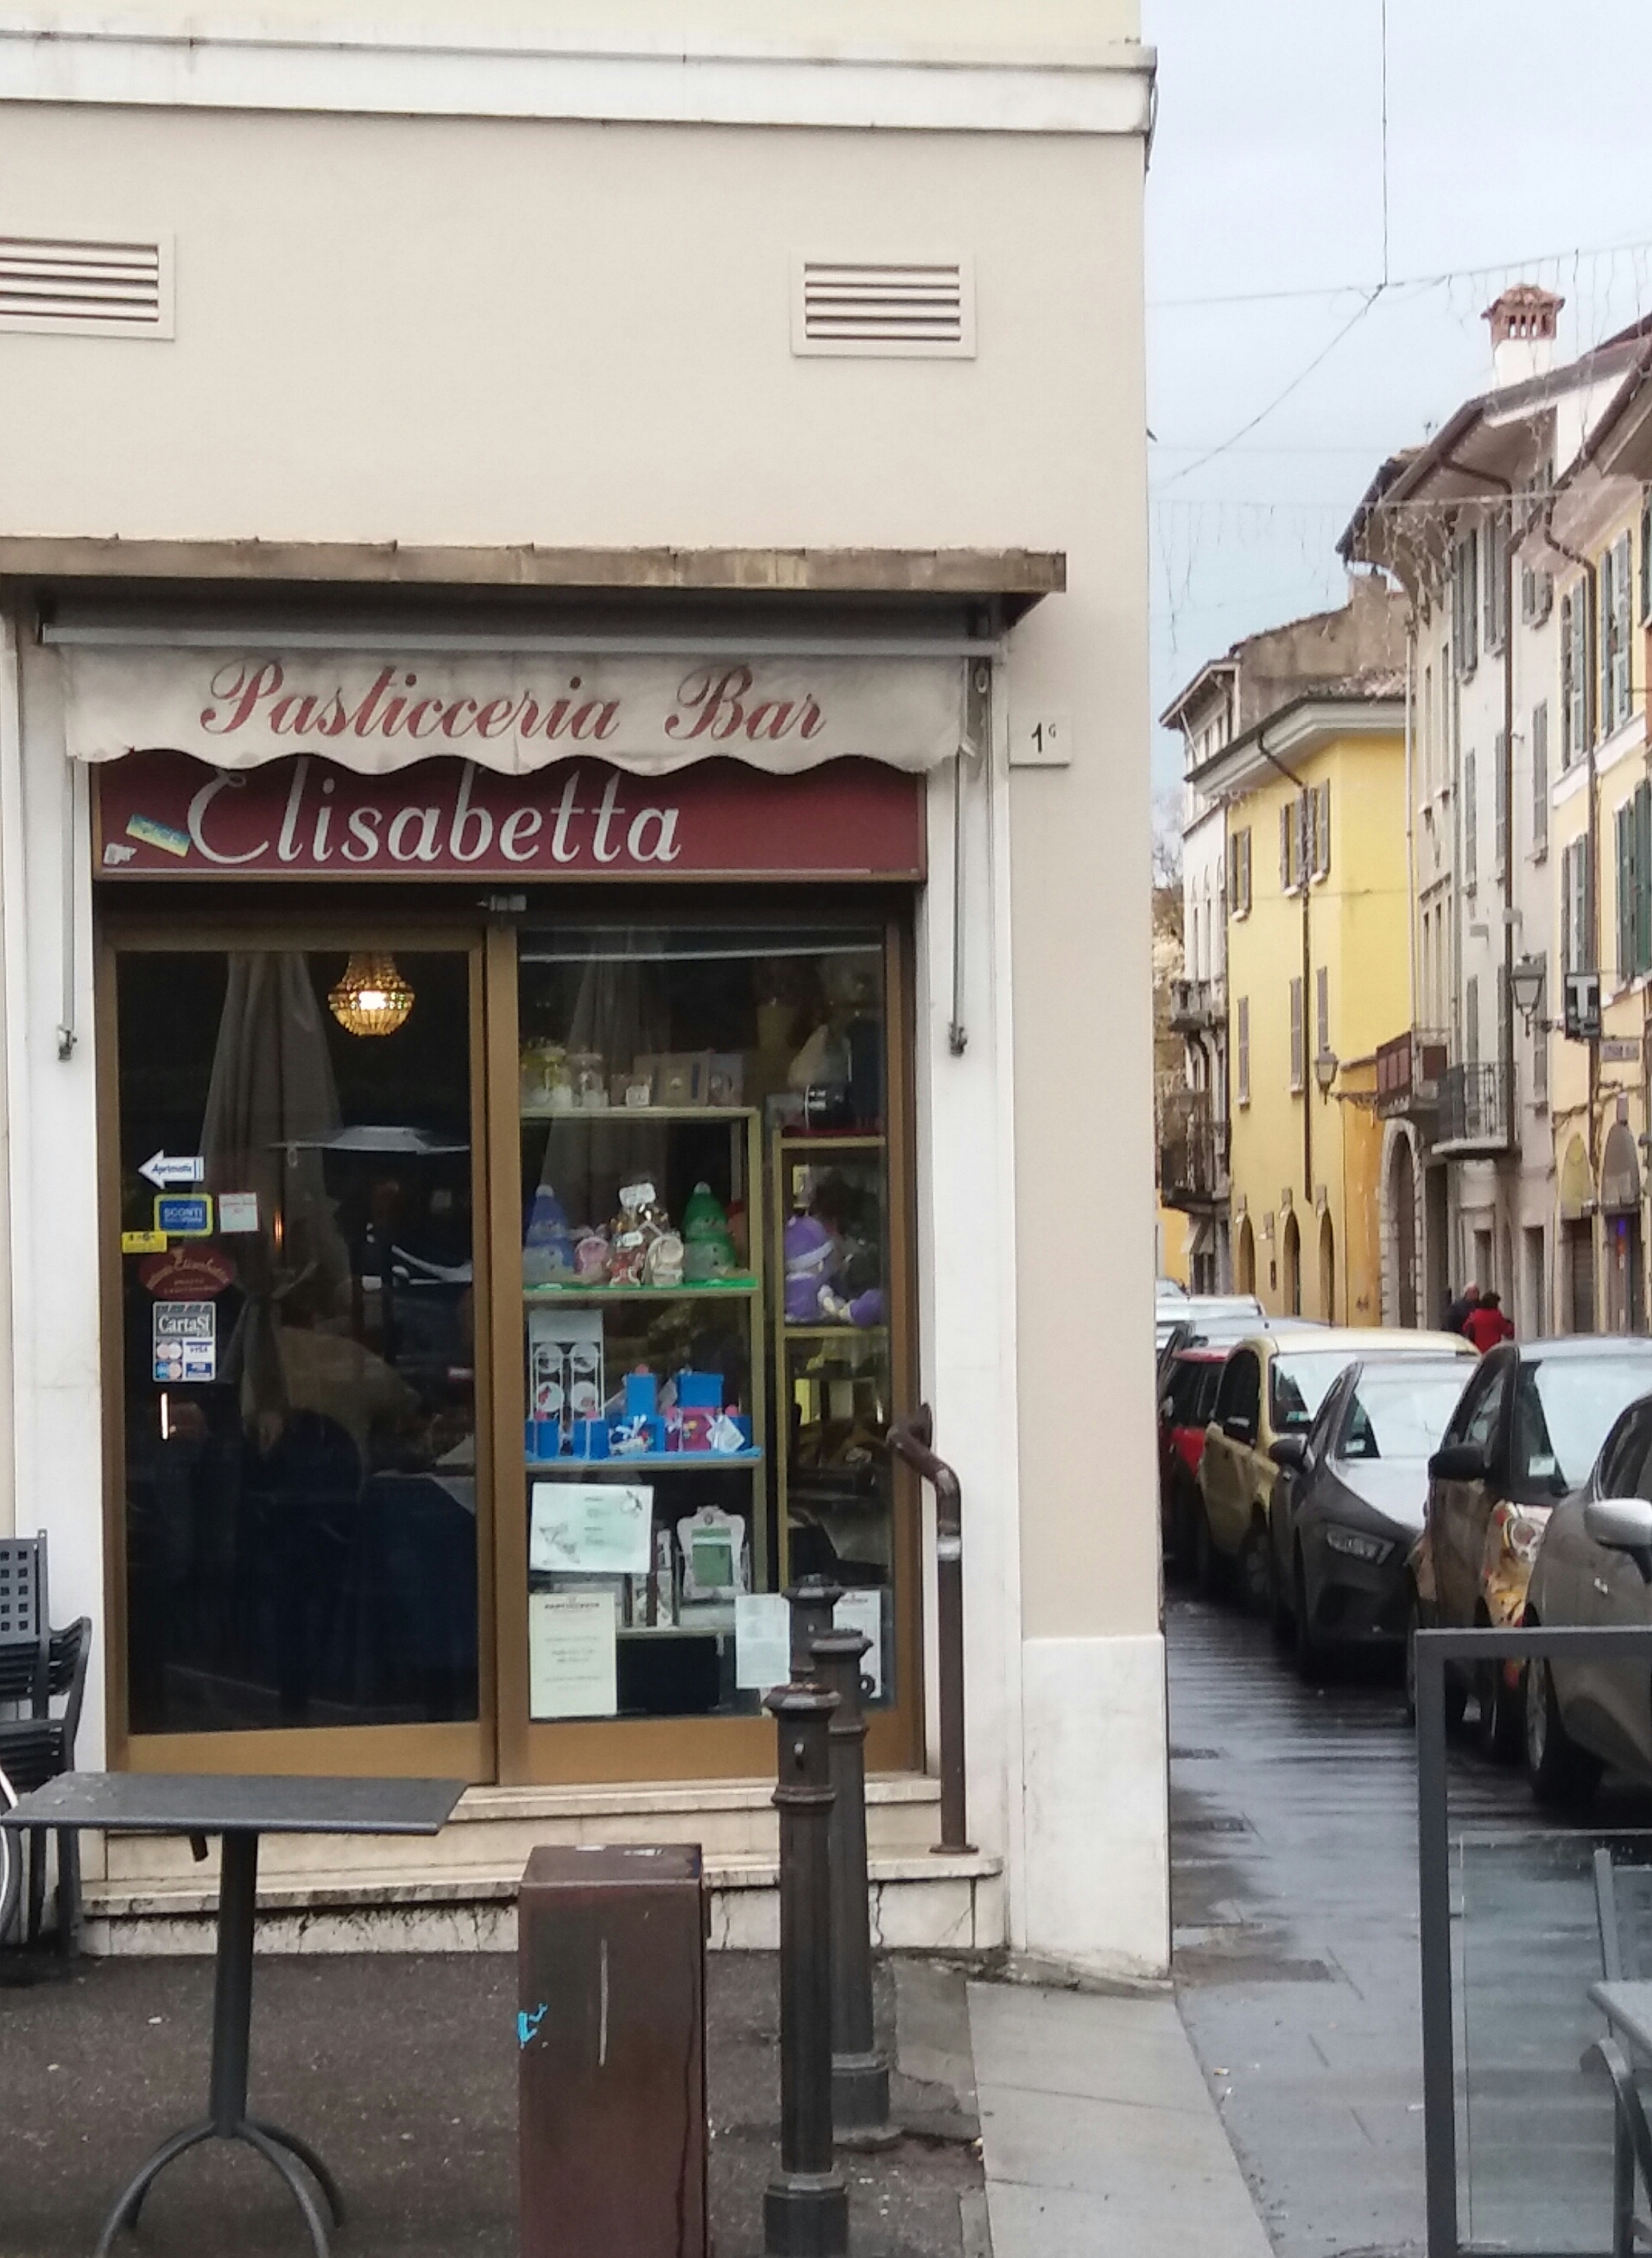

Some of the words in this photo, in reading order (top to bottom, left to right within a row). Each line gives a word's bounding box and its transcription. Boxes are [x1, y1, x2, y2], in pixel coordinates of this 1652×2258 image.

[199, 656, 620, 741] Pasticceria
[664, 663, 826, 741] Bar
[1567, 975, 1598, 1019] T
